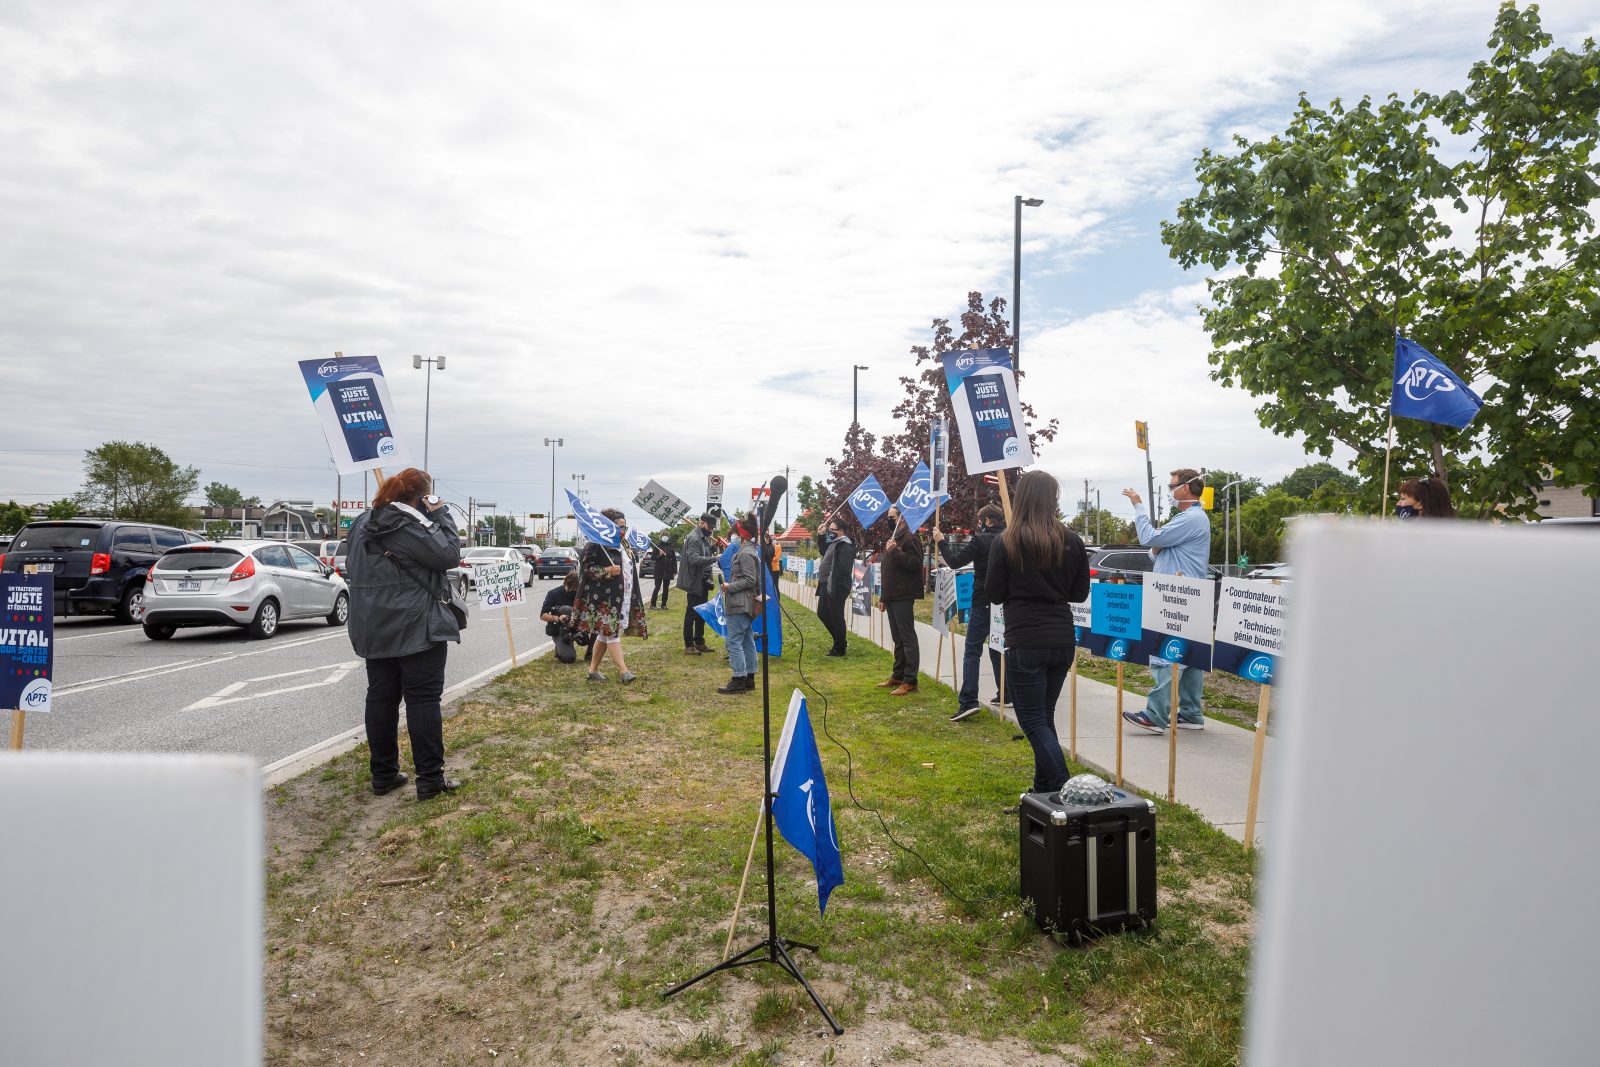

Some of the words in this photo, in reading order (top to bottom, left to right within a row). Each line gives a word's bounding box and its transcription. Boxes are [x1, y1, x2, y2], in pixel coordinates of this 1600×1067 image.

[956, 358, 974, 367] APTS
[318, 365, 338, 375] APTS
[1396, 367, 1456, 392] APTS
[341, 389, 369, 399] JUSTE
[976, 386, 998, 395] JUSTE
[342, 410, 383, 424] VITAL
[976, 408, 1008, 421] VITAL
[635, 492, 655, 509] Nous
[853, 489, 881, 512] APTS
[901, 481, 934, 508] APTS
[475, 566, 497, 578] Nous
[498, 561, 520, 573] voulons
[1155, 581, 1169, 593] Agent
[1170, 582, 1177, 592] de
[1177, 583, 1201, 597] relations
[1229, 586, 1276, 604] Coordonateur
[8, 592, 43, 604] JUSTE
[1162, 593, 1188, 606] humaines
[14, 603, 42, 611] ÉQUITABLE
[1233, 601, 1241, 610] en
[1242, 602, 1262, 614] génie
[1163, 609, 1189, 623] Travailleur
[1166, 622, 1182, 633] social
[1243, 619, 1281, 637] Technicien
[0, 628, 49, 647] VITAL
[1233, 631, 1253, 643] génie
[0, 645, 16, 654] OUR
[18, 646, 48, 656] SORTIR
[22, 655, 48, 664] CRISE
[1253, 663, 1270, 673] APTS
[25, 692, 47, 703] APTS
